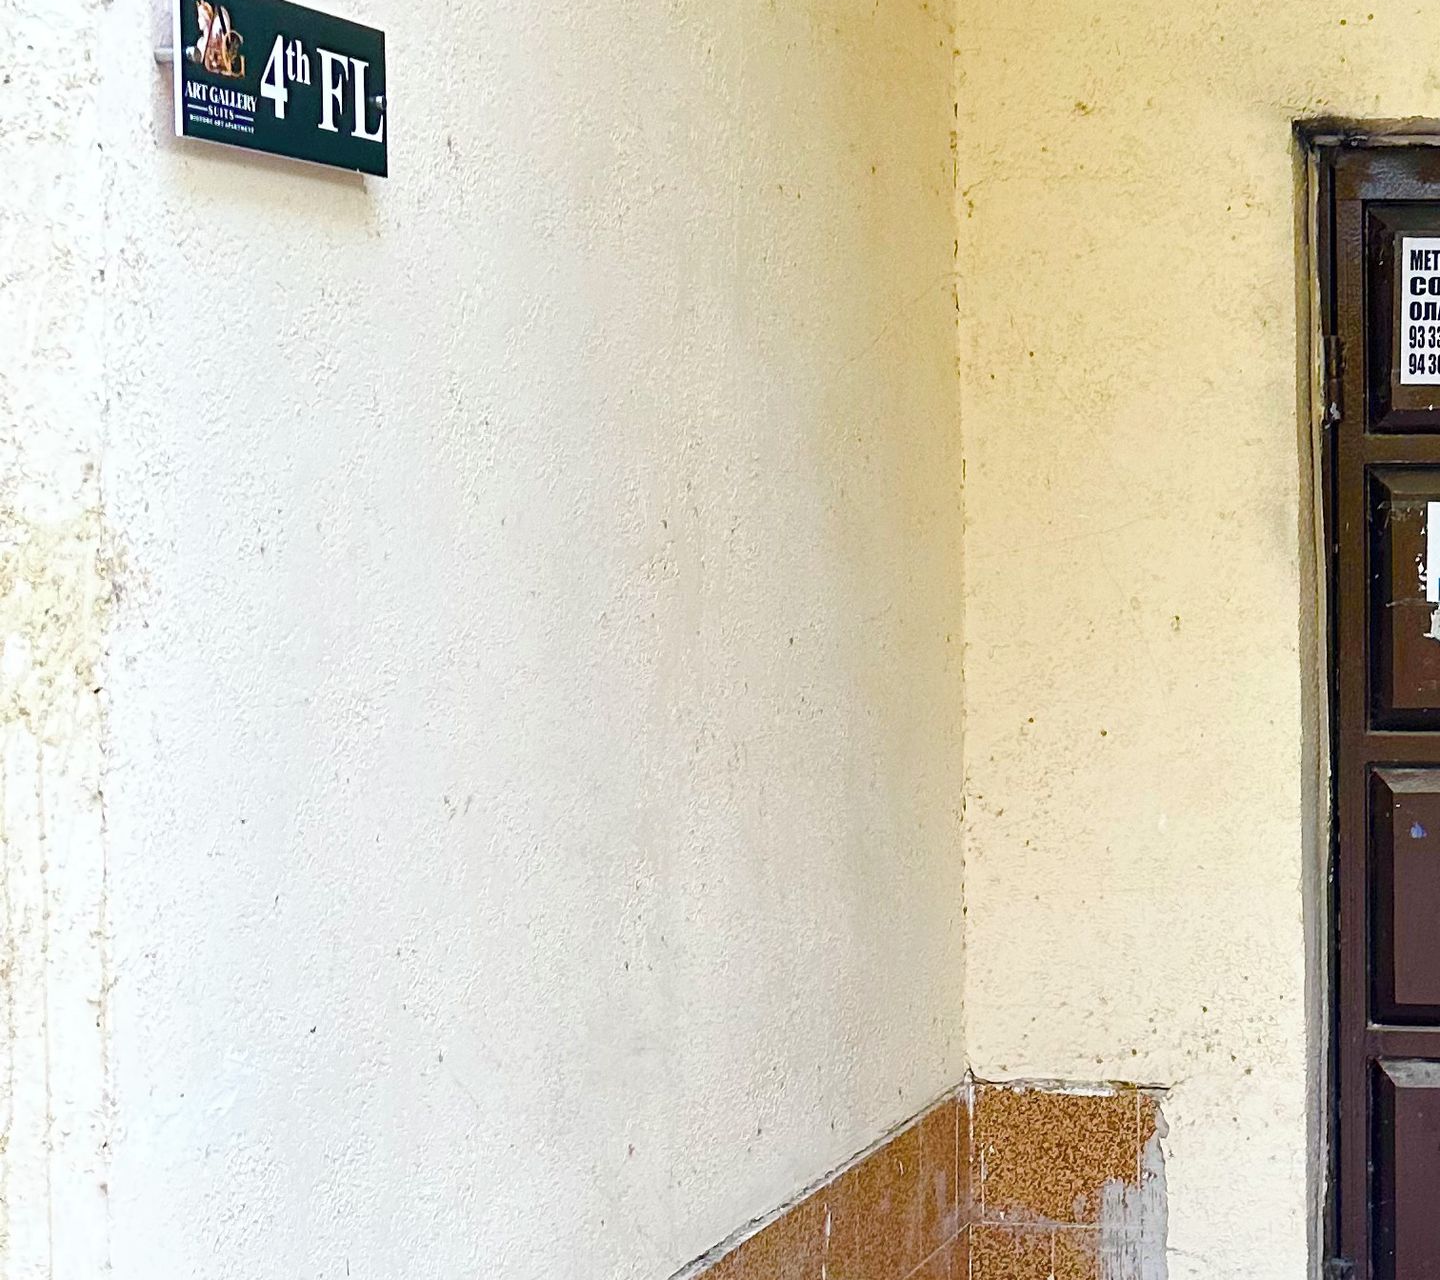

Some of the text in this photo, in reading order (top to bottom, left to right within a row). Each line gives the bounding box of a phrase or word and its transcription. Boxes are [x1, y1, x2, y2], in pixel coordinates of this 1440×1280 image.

[185, 80, 258, 113] ART GALLERY
[260, 34, 384, 143] 4th FL
[208, 104, 234, 120] SUITS
[1409, 325, 1426, 349] 93
[1409, 353, 1426, 375] 94
